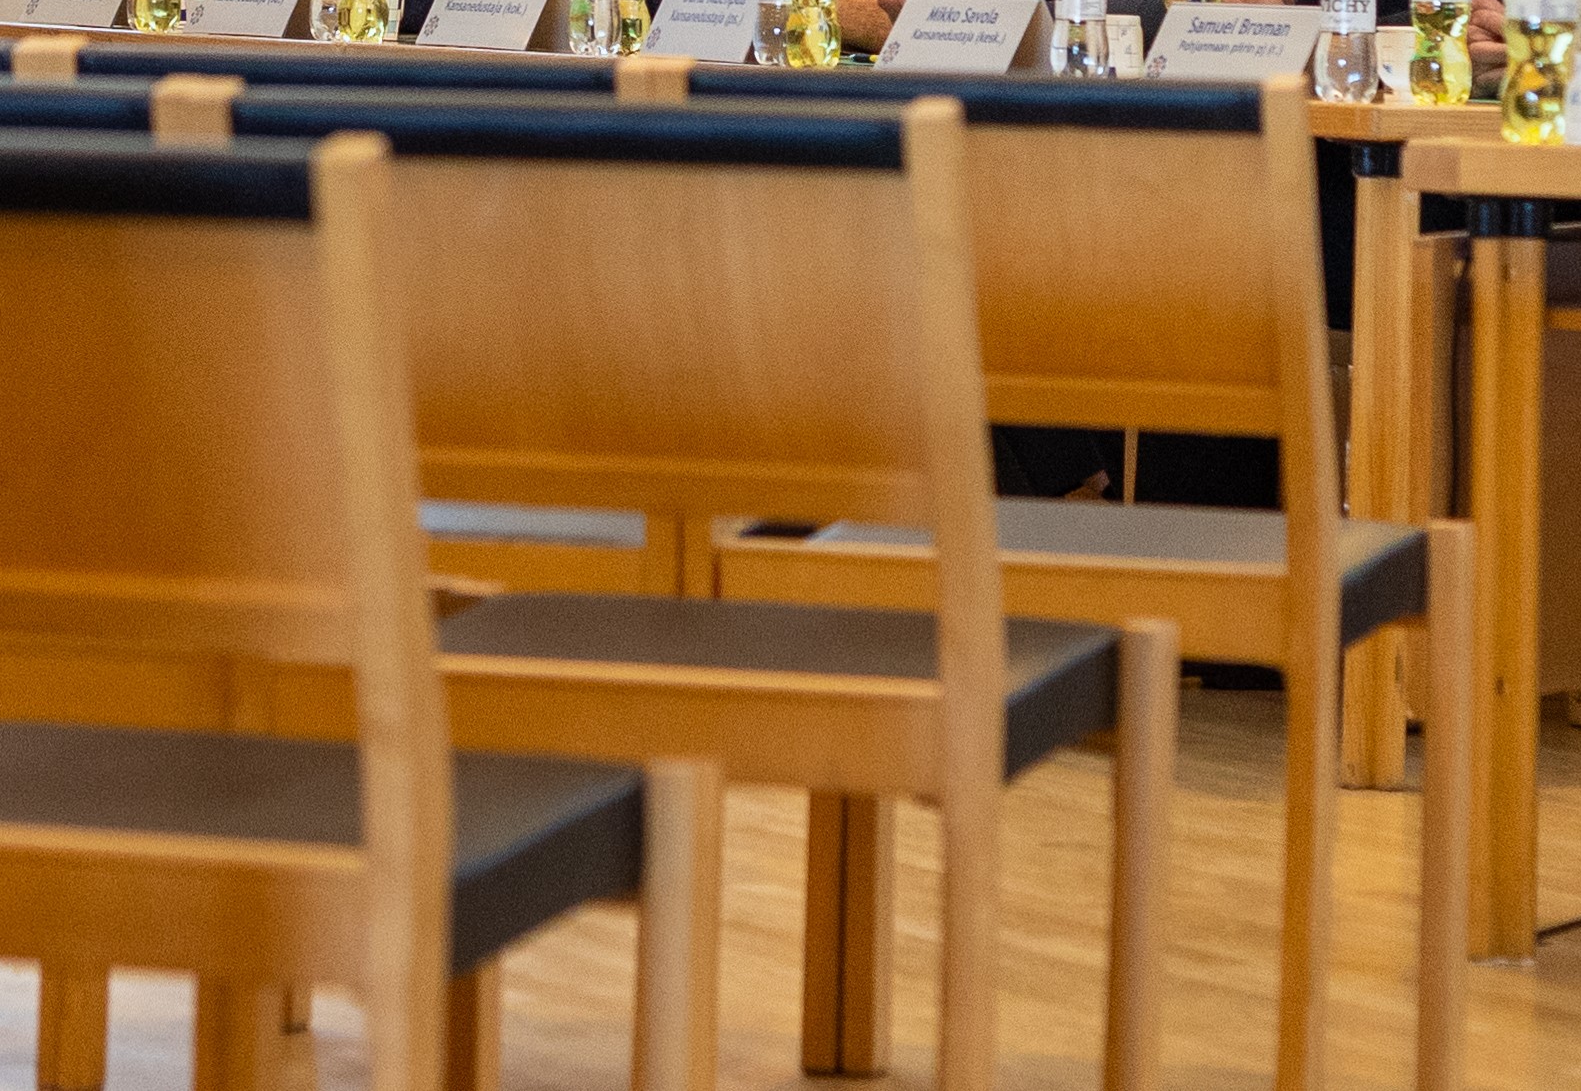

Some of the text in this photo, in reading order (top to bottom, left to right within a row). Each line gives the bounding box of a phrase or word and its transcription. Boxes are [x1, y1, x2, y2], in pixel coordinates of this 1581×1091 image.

[445, 0, 502, 16] Kansanedustaja
[926, 6, 999, 24] Mikko Savola
[1187, 16, 1291, 37] Samuel Broman
